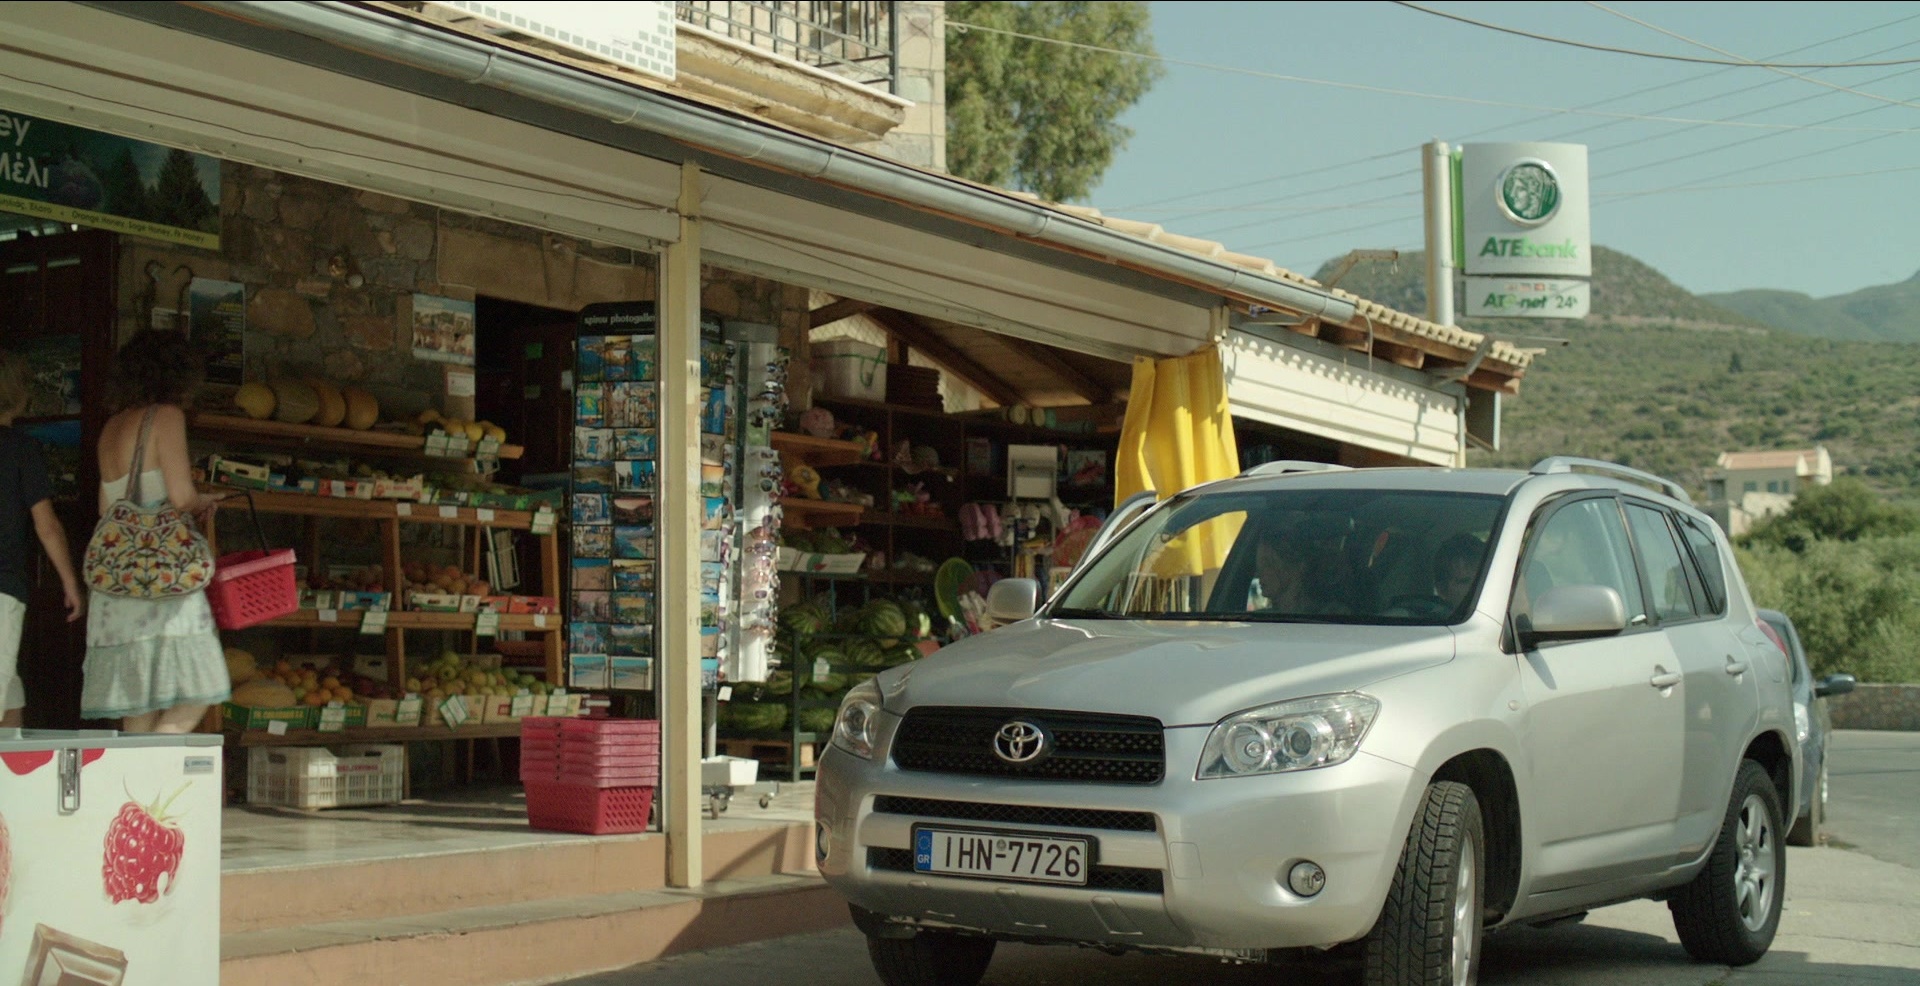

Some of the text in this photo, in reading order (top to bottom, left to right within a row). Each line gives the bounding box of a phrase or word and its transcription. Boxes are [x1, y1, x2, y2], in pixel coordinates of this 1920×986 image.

[1479, 235, 1577, 258] ATEbank
[917, 854, 930, 864] GR
[945, 836, 1080, 878] IHN-7726
